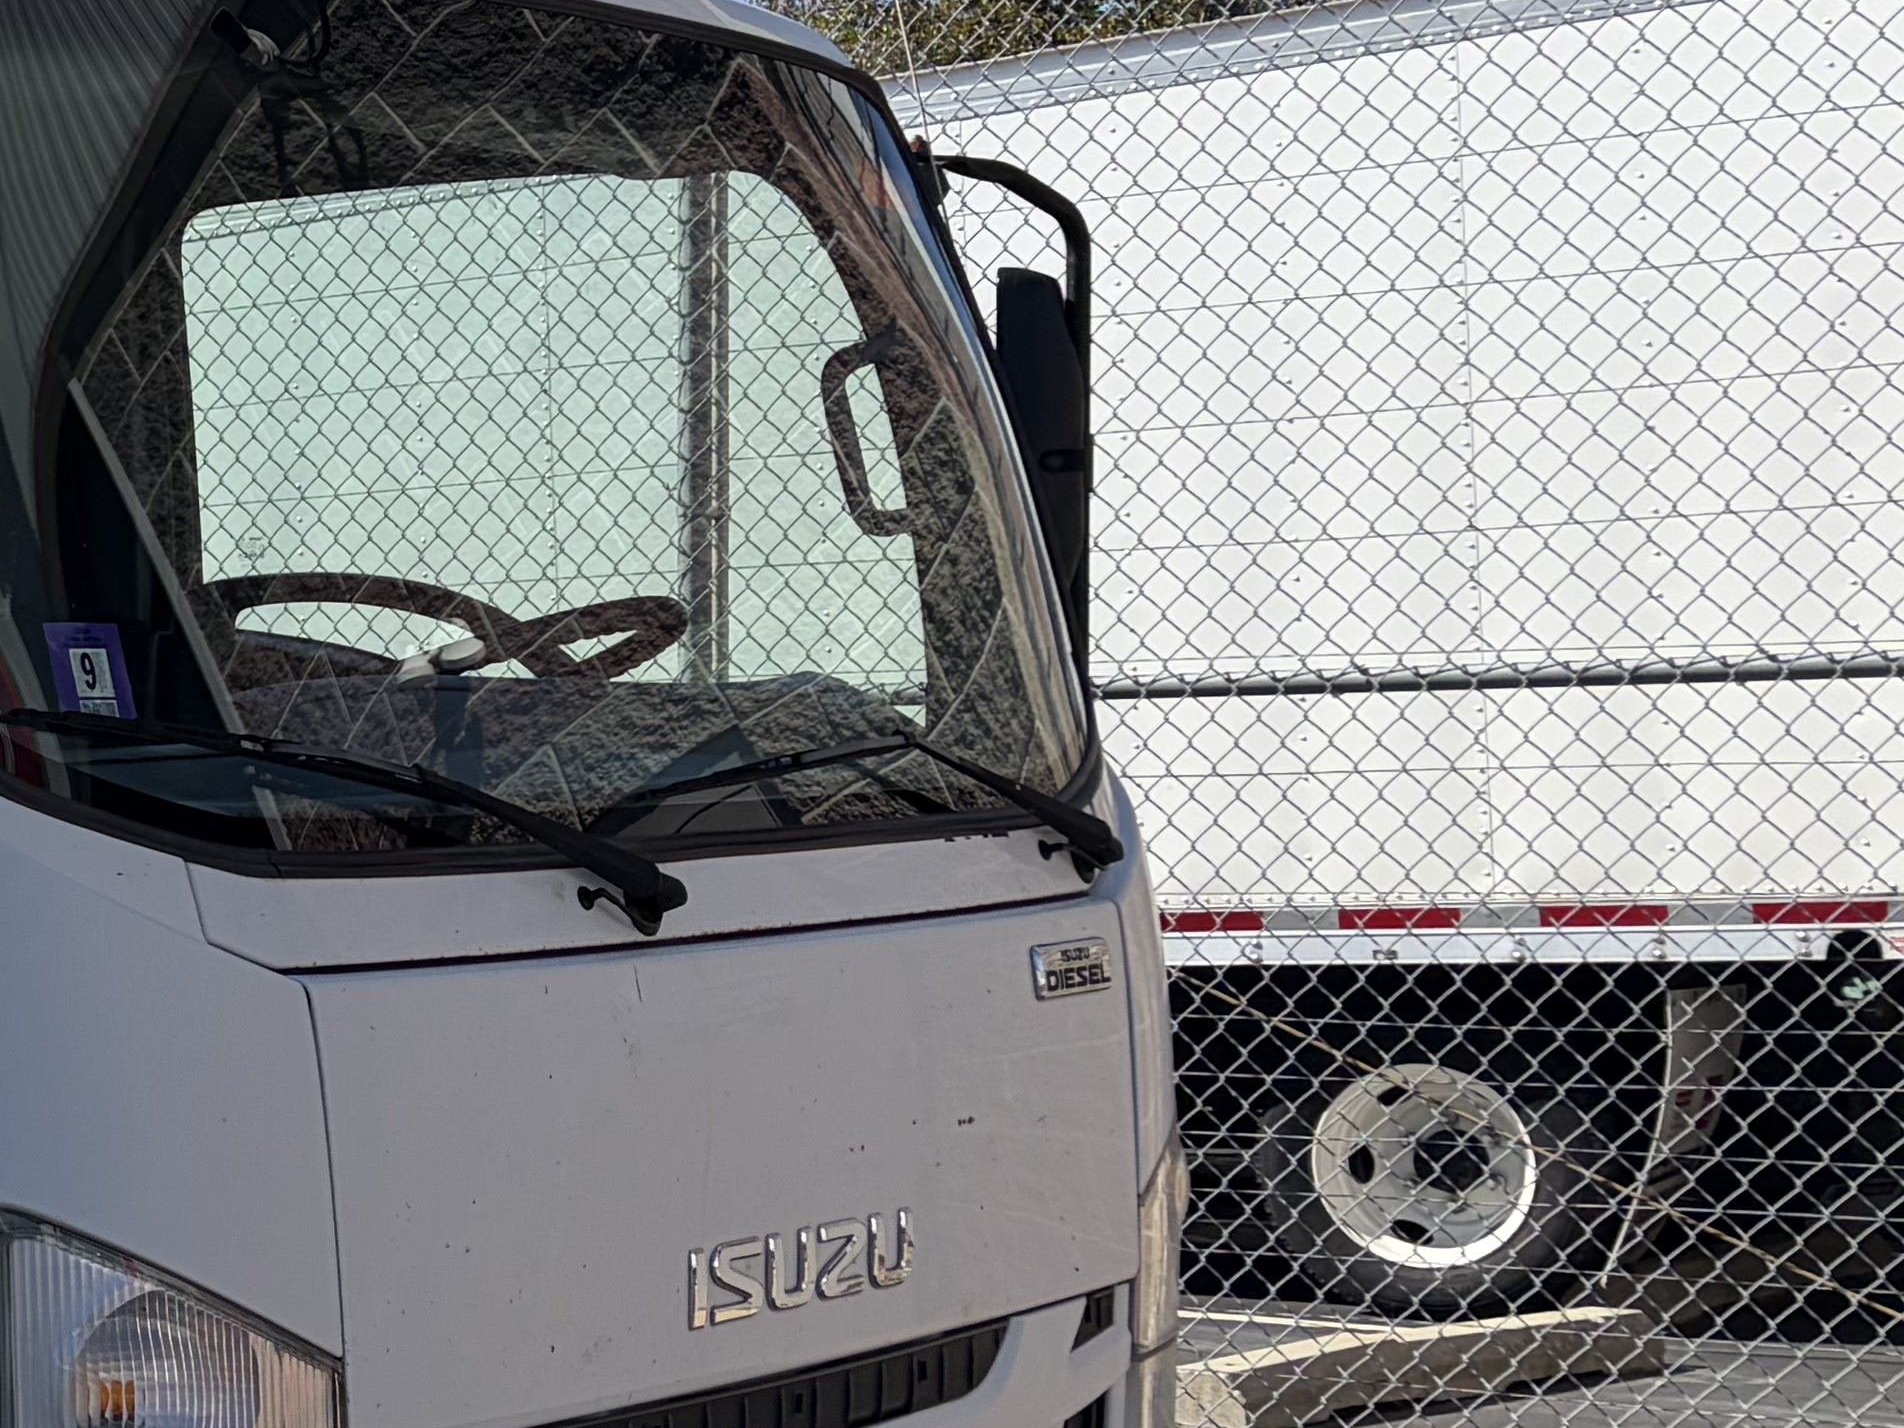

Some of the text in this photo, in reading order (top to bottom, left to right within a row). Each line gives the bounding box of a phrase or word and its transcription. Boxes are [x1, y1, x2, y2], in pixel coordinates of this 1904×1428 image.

[80, 652, 97, 691] 9
[1059, 946, 1090, 962] ISUZU
[1046, 959, 1112, 992] DIESEL
[688, 1206, 915, 1332] ISUZU
